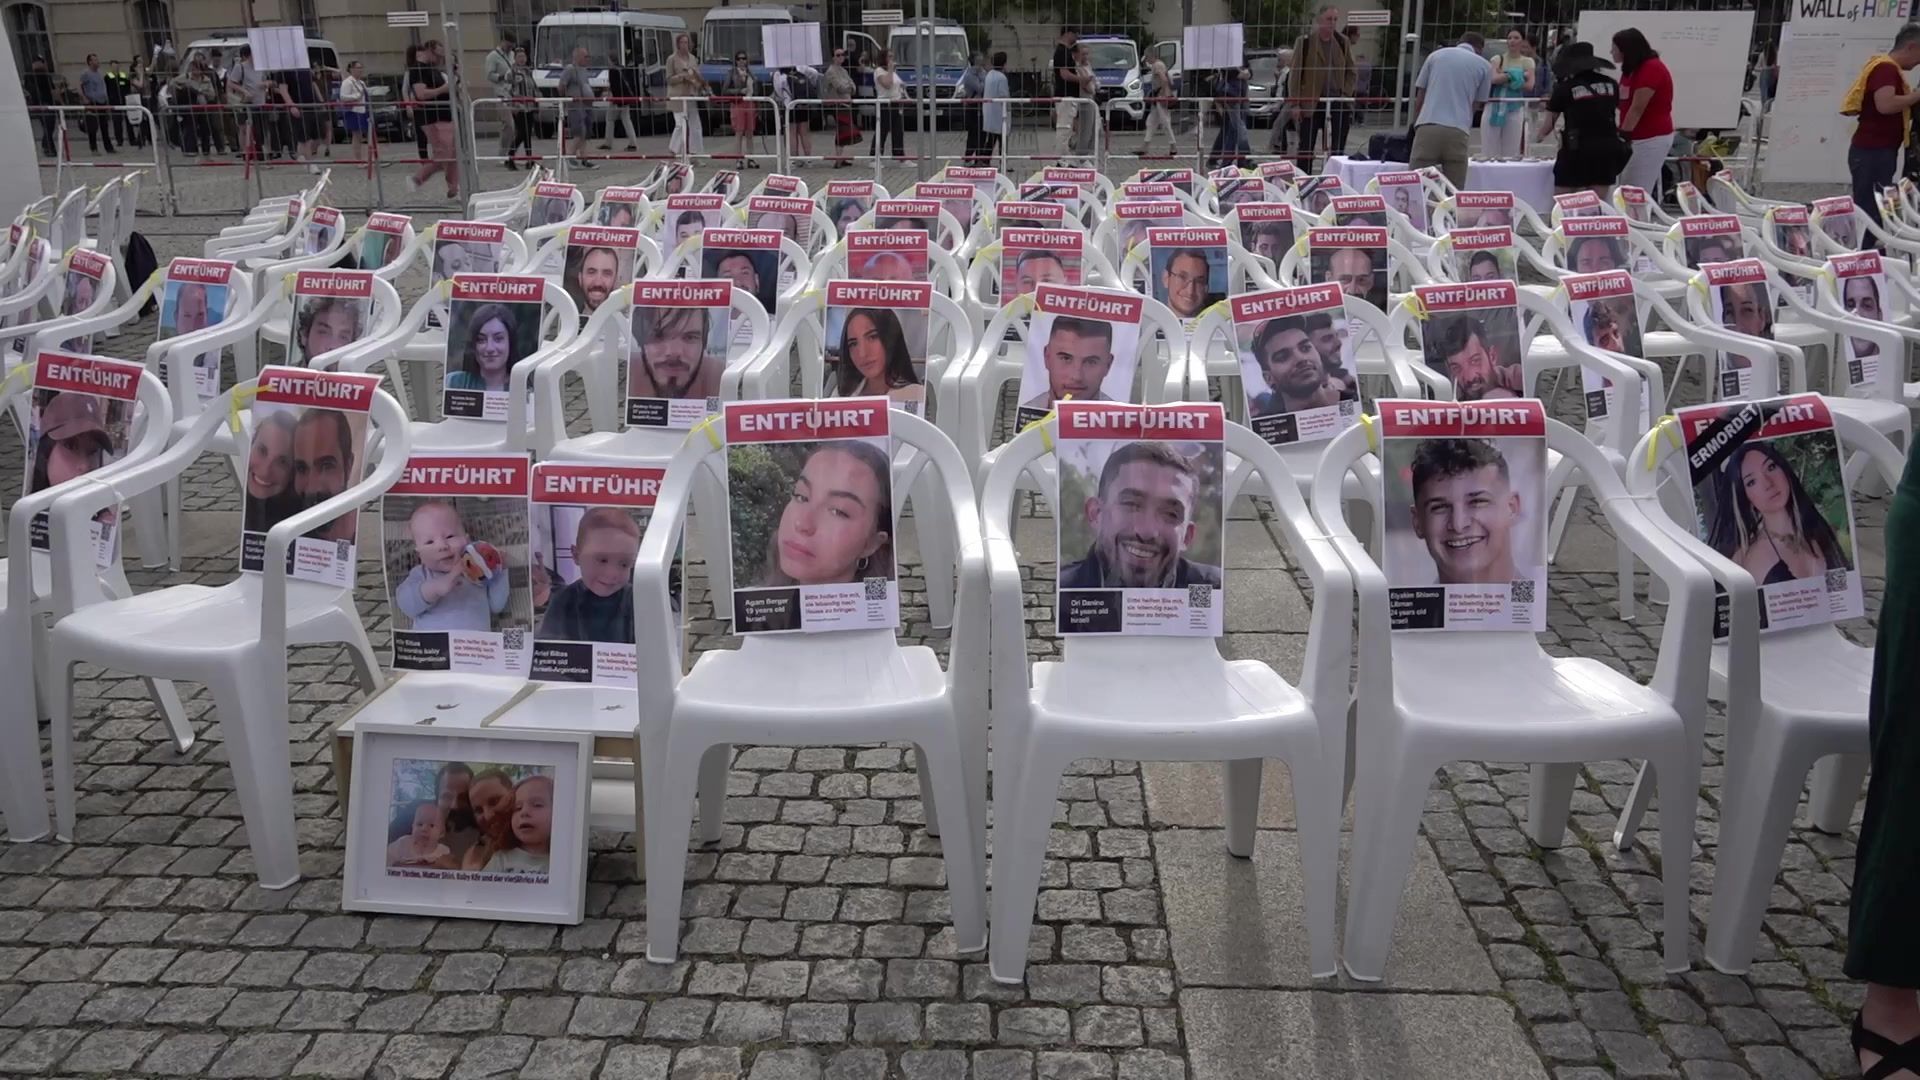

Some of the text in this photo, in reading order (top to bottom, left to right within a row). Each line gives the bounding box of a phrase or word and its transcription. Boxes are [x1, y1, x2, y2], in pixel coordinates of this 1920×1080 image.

[1800, 0, 1909, 22] WALL of HOPE
[832, 185, 871, 194] ENTFÜHRT
[920, 186, 968, 196] ENTFÜHRT
[672, 197, 717, 207] ENTFÜHRT
[755, 199, 808, 213] ENTFÜHRT
[1337, 198, 1380, 209] ENTFÜHRT
[1460, 194, 1509, 205] ENTFÜHRT
[880, 202, 934, 213] ENTFÜHRT
[1002, 203, 1058, 216] ENTFÜHRT
[1121, 204, 1176, 215] ENTFÜHRT
[1242, 206, 1287, 217] ENTFÜHRT
[442, 224, 498, 238] ENTFÜHRT
[1568, 219, 1622, 231] ENTFÜHRT
[1686, 219, 1735, 231] ENTFÜHRT
[575, 230, 632, 243] ENTFÜHRT
[710, 231, 775, 244] ENTFÜHRT
[854, 231, 921, 246] ENTFÜHRT
[1009, 231, 1076, 245] ENTFÜHRT
[1155, 231, 1220, 242] ENTFÜHRT
[1316, 231, 1381, 243] ENTFÜHRT
[1456, 231, 1507, 245] ENTFÜHRT
[173, 262, 226, 278] ENTFÜHRT
[1711, 264, 1760, 280] ENTFÜHRT
[303, 276, 367, 291] ENTFÜHRT
[460, 279, 537, 295] ENTFÜHRT
[1572, 277, 1626, 294] ENTFÜHRT
[642, 285, 724, 301] ENTFÜHRT
[836, 286, 923, 302] ENTFÜHRT
[1425, 286, 1507, 304] ENTFÜHRT
[1044, 294, 1133, 316] ENTFÜHRT
[1241, 288, 1332, 316] ENTFÜHRT
[47, 363, 132, 390] ENTFÜHRT
[268, 377, 365, 400] ENTFÜHRT
[740, 407, 874, 432] ENTFÜHRT
[1073, 409, 1209, 429] ENTFÜHRT
[1396, 404, 1530, 426] ENTFÜHRT
[1690, 403, 1759, 469] ERMORDET
[399, 464, 516, 485] ENTFÜHRT
[745, 599, 765, 608] Agam
[755, 607, 774, 615] years
